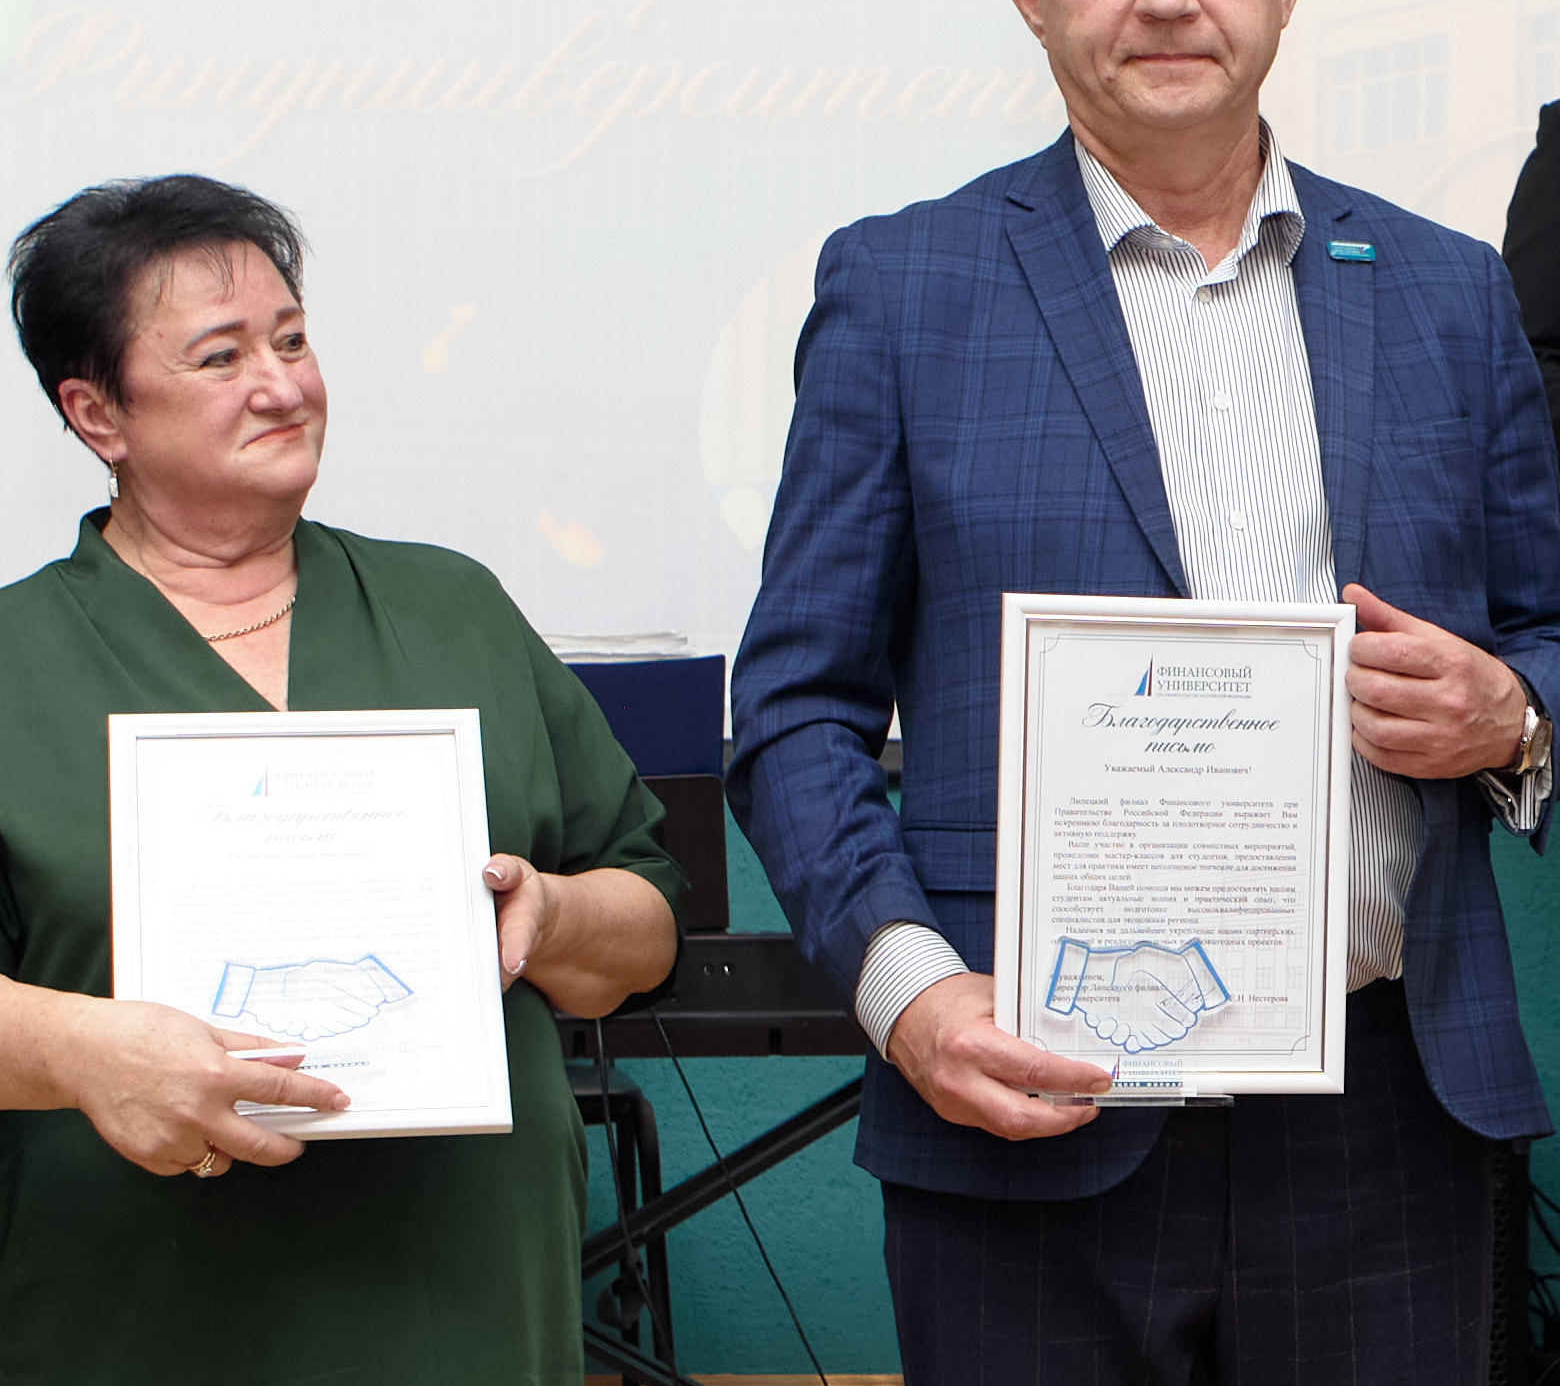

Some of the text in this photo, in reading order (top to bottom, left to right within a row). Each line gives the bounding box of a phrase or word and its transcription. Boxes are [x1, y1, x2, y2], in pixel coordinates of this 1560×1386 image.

[1157, 665, 1252, 679] ФИНАНСОВЫЙ
[1157, 680, 1252, 693] УНИВЕРСИТЕТ
[1082, 702, 1281, 736] Благодарственное
[1144, 741, 1216, 754] письмо
[1104, 764, 1252, 776] Уважаемый Александр Иванович!
